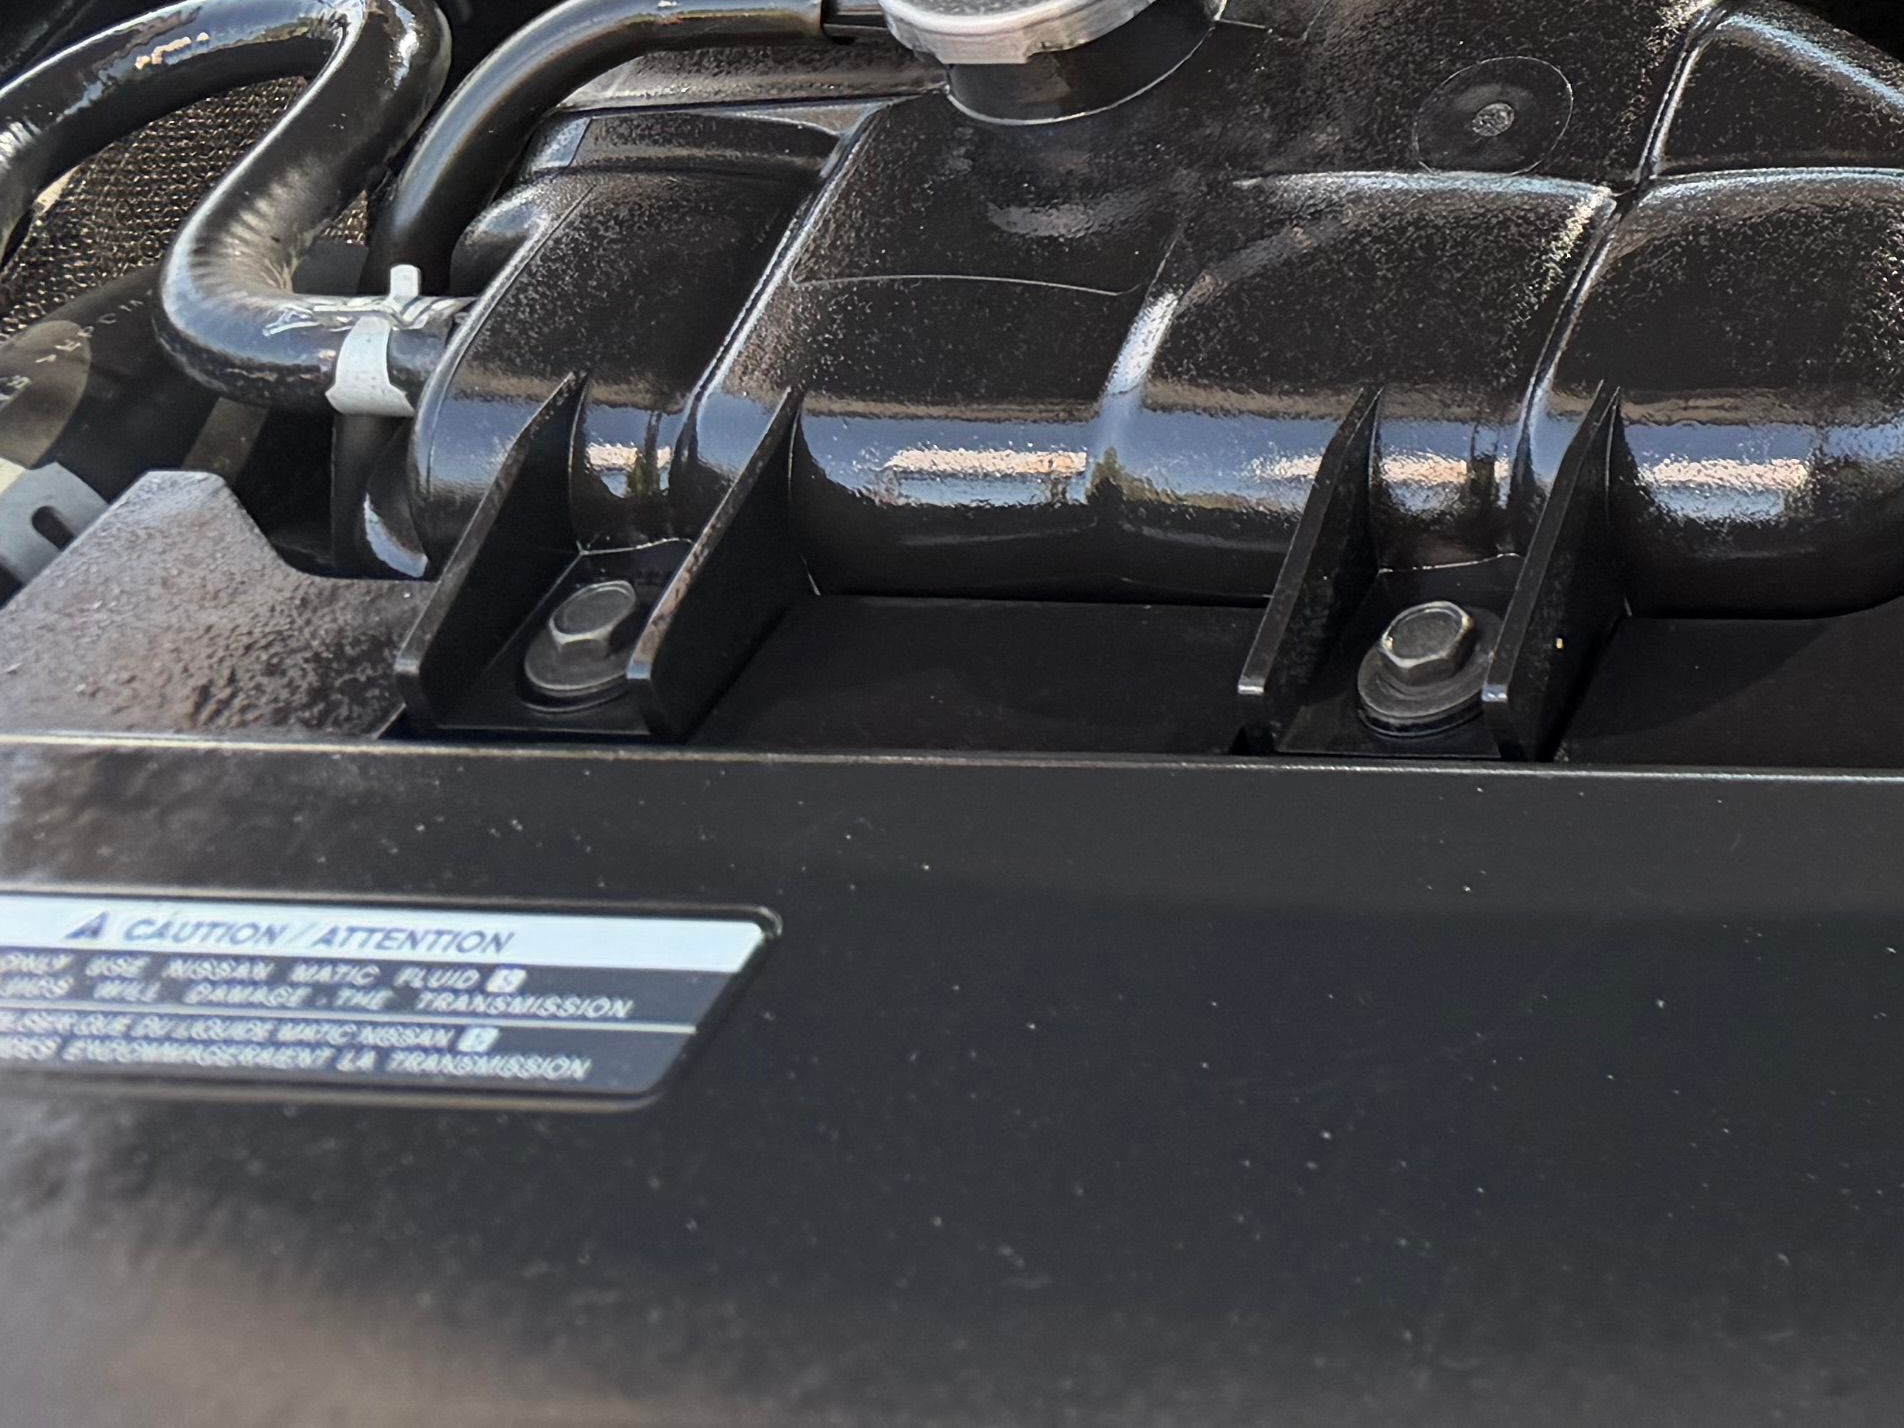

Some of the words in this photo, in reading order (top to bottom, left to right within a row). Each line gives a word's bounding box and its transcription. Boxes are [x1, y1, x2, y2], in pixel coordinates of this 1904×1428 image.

[124, 917, 288, 946] CAUTION
[312, 924, 516, 955] ATTENTION
[288, 961, 381, 987] MATIC
[393, 966, 482, 990] FLUID
[415, 992, 636, 1019] TRANSMISSION
[360, 1023, 454, 1048] NISSAN
[386, 1052, 592, 1081] TRANSMISSION
